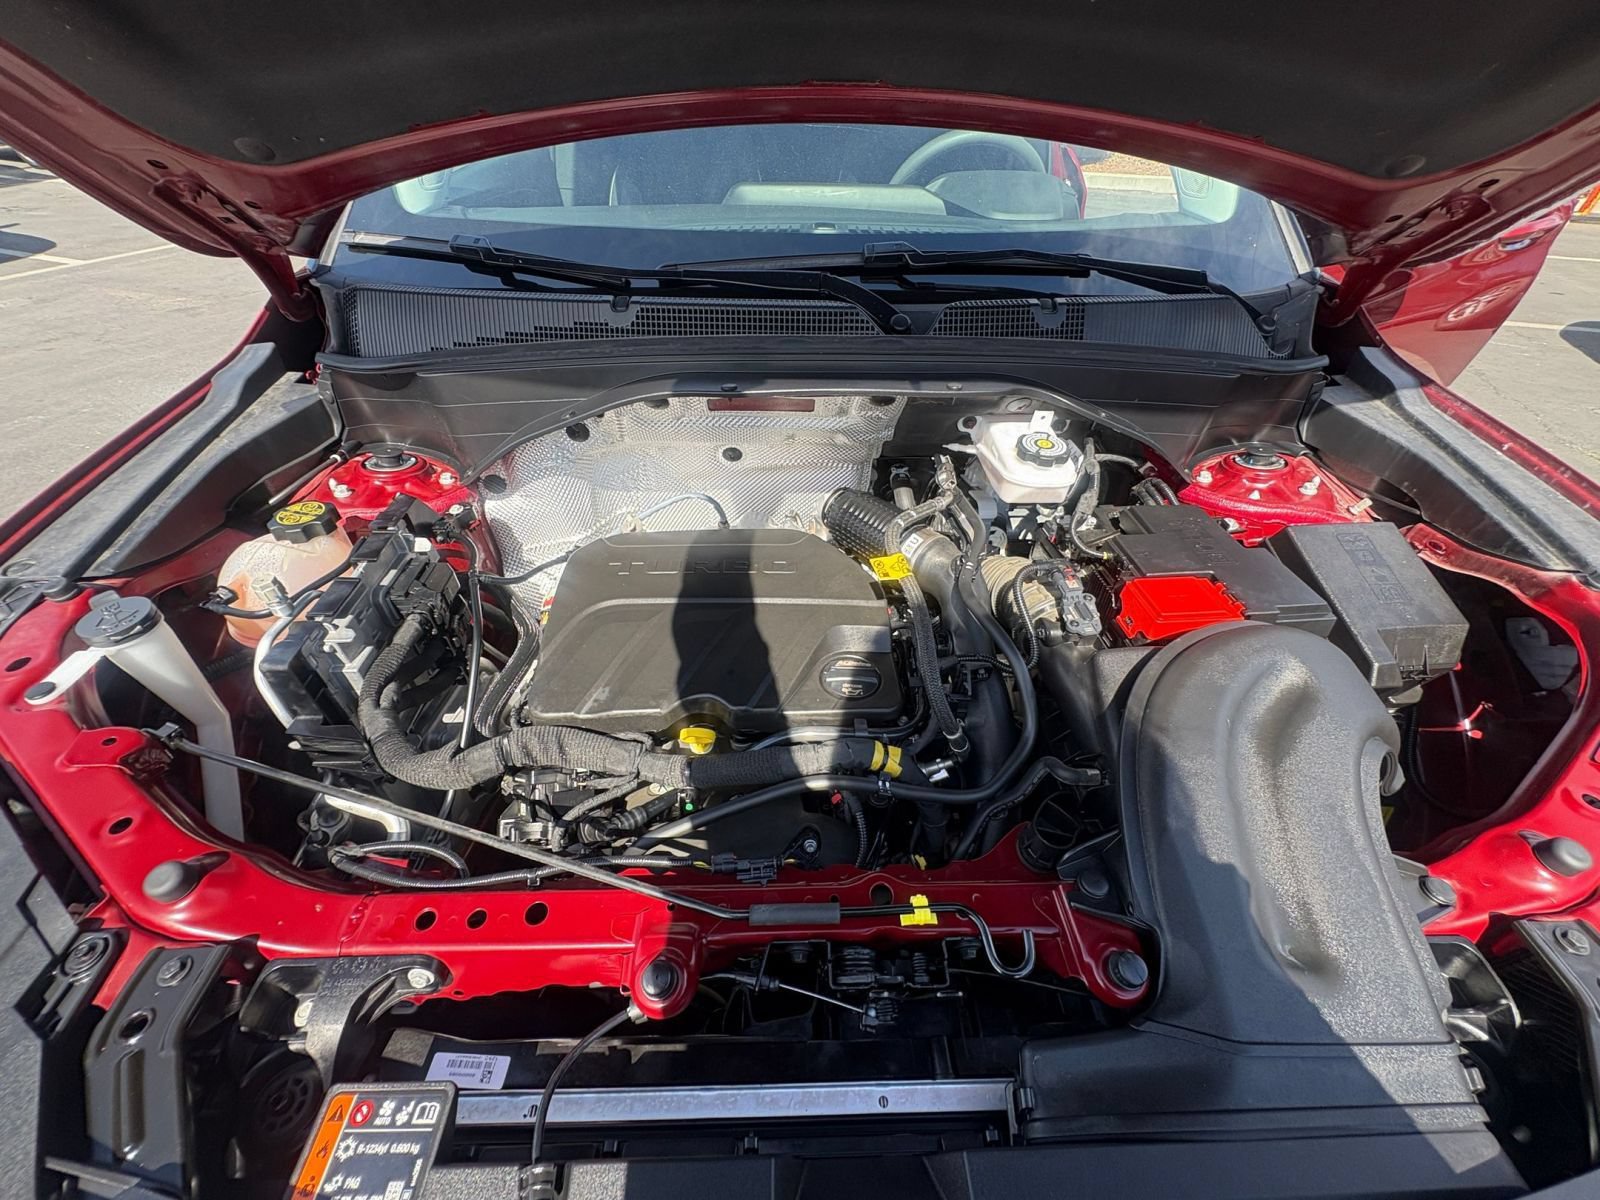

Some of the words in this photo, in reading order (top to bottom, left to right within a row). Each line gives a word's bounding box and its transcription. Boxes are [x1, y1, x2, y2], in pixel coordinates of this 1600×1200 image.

[608, 559, 797, 575] TURBO
[374, 1118, 392, 1126] AUTO
[357, 1144, 390, 1155] R-1234yf
[411, 1144, 420, 1155] kg
[344, 1176, 361, 1189] PAG
